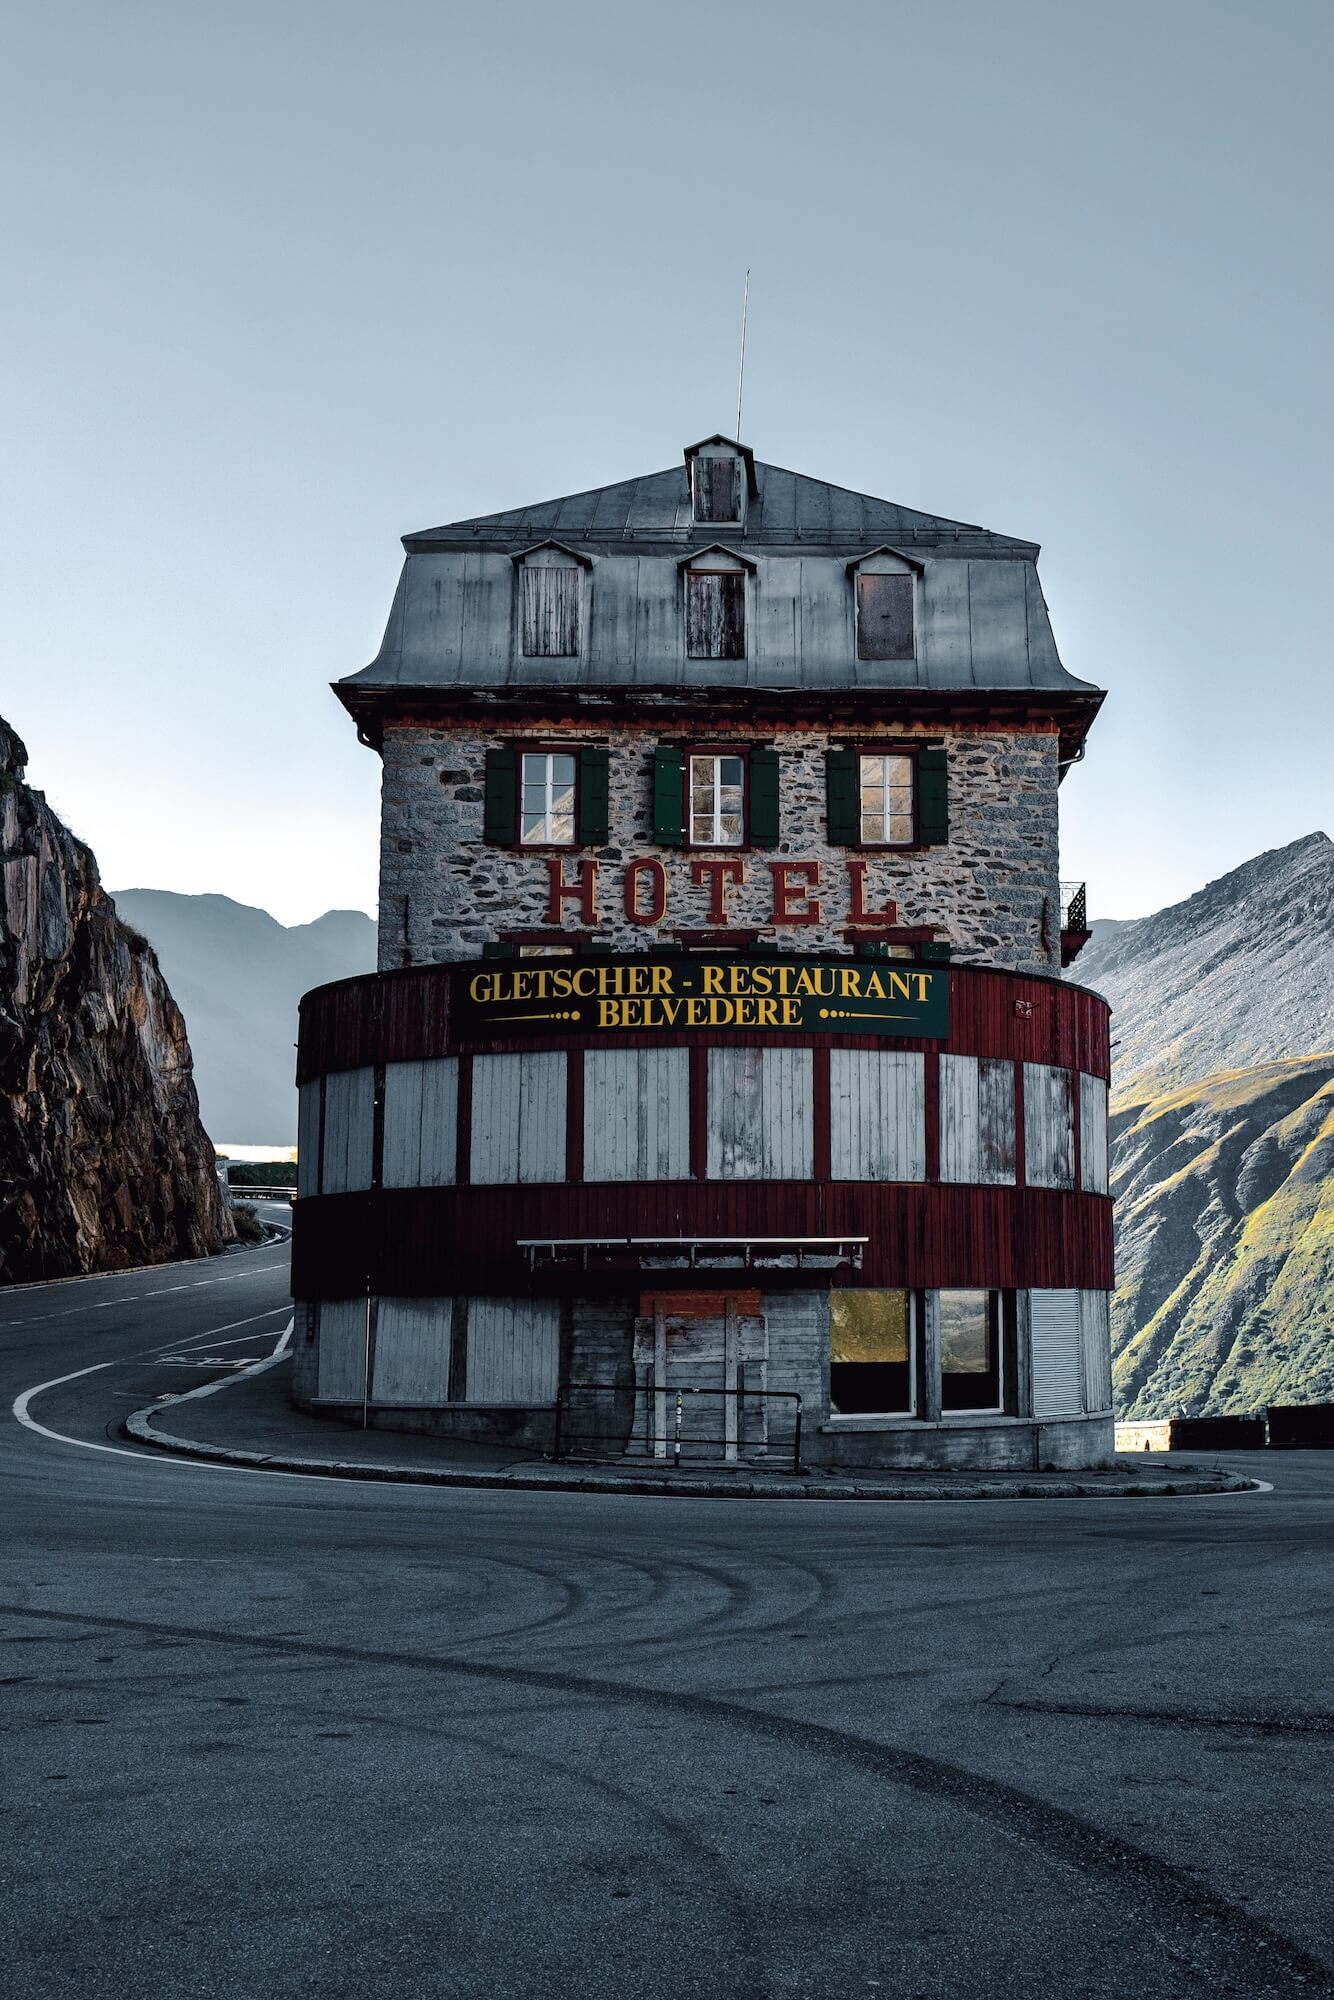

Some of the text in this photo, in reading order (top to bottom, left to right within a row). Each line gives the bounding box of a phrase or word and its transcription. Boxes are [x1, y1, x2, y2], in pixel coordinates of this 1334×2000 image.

[544, 858, 898, 925] HOTEL
[469, 966, 674, 1002] GLETSCHER
[701, 965, 932, 1001] RESTAURANT
[596, 997, 803, 1027] BELVEDERE
